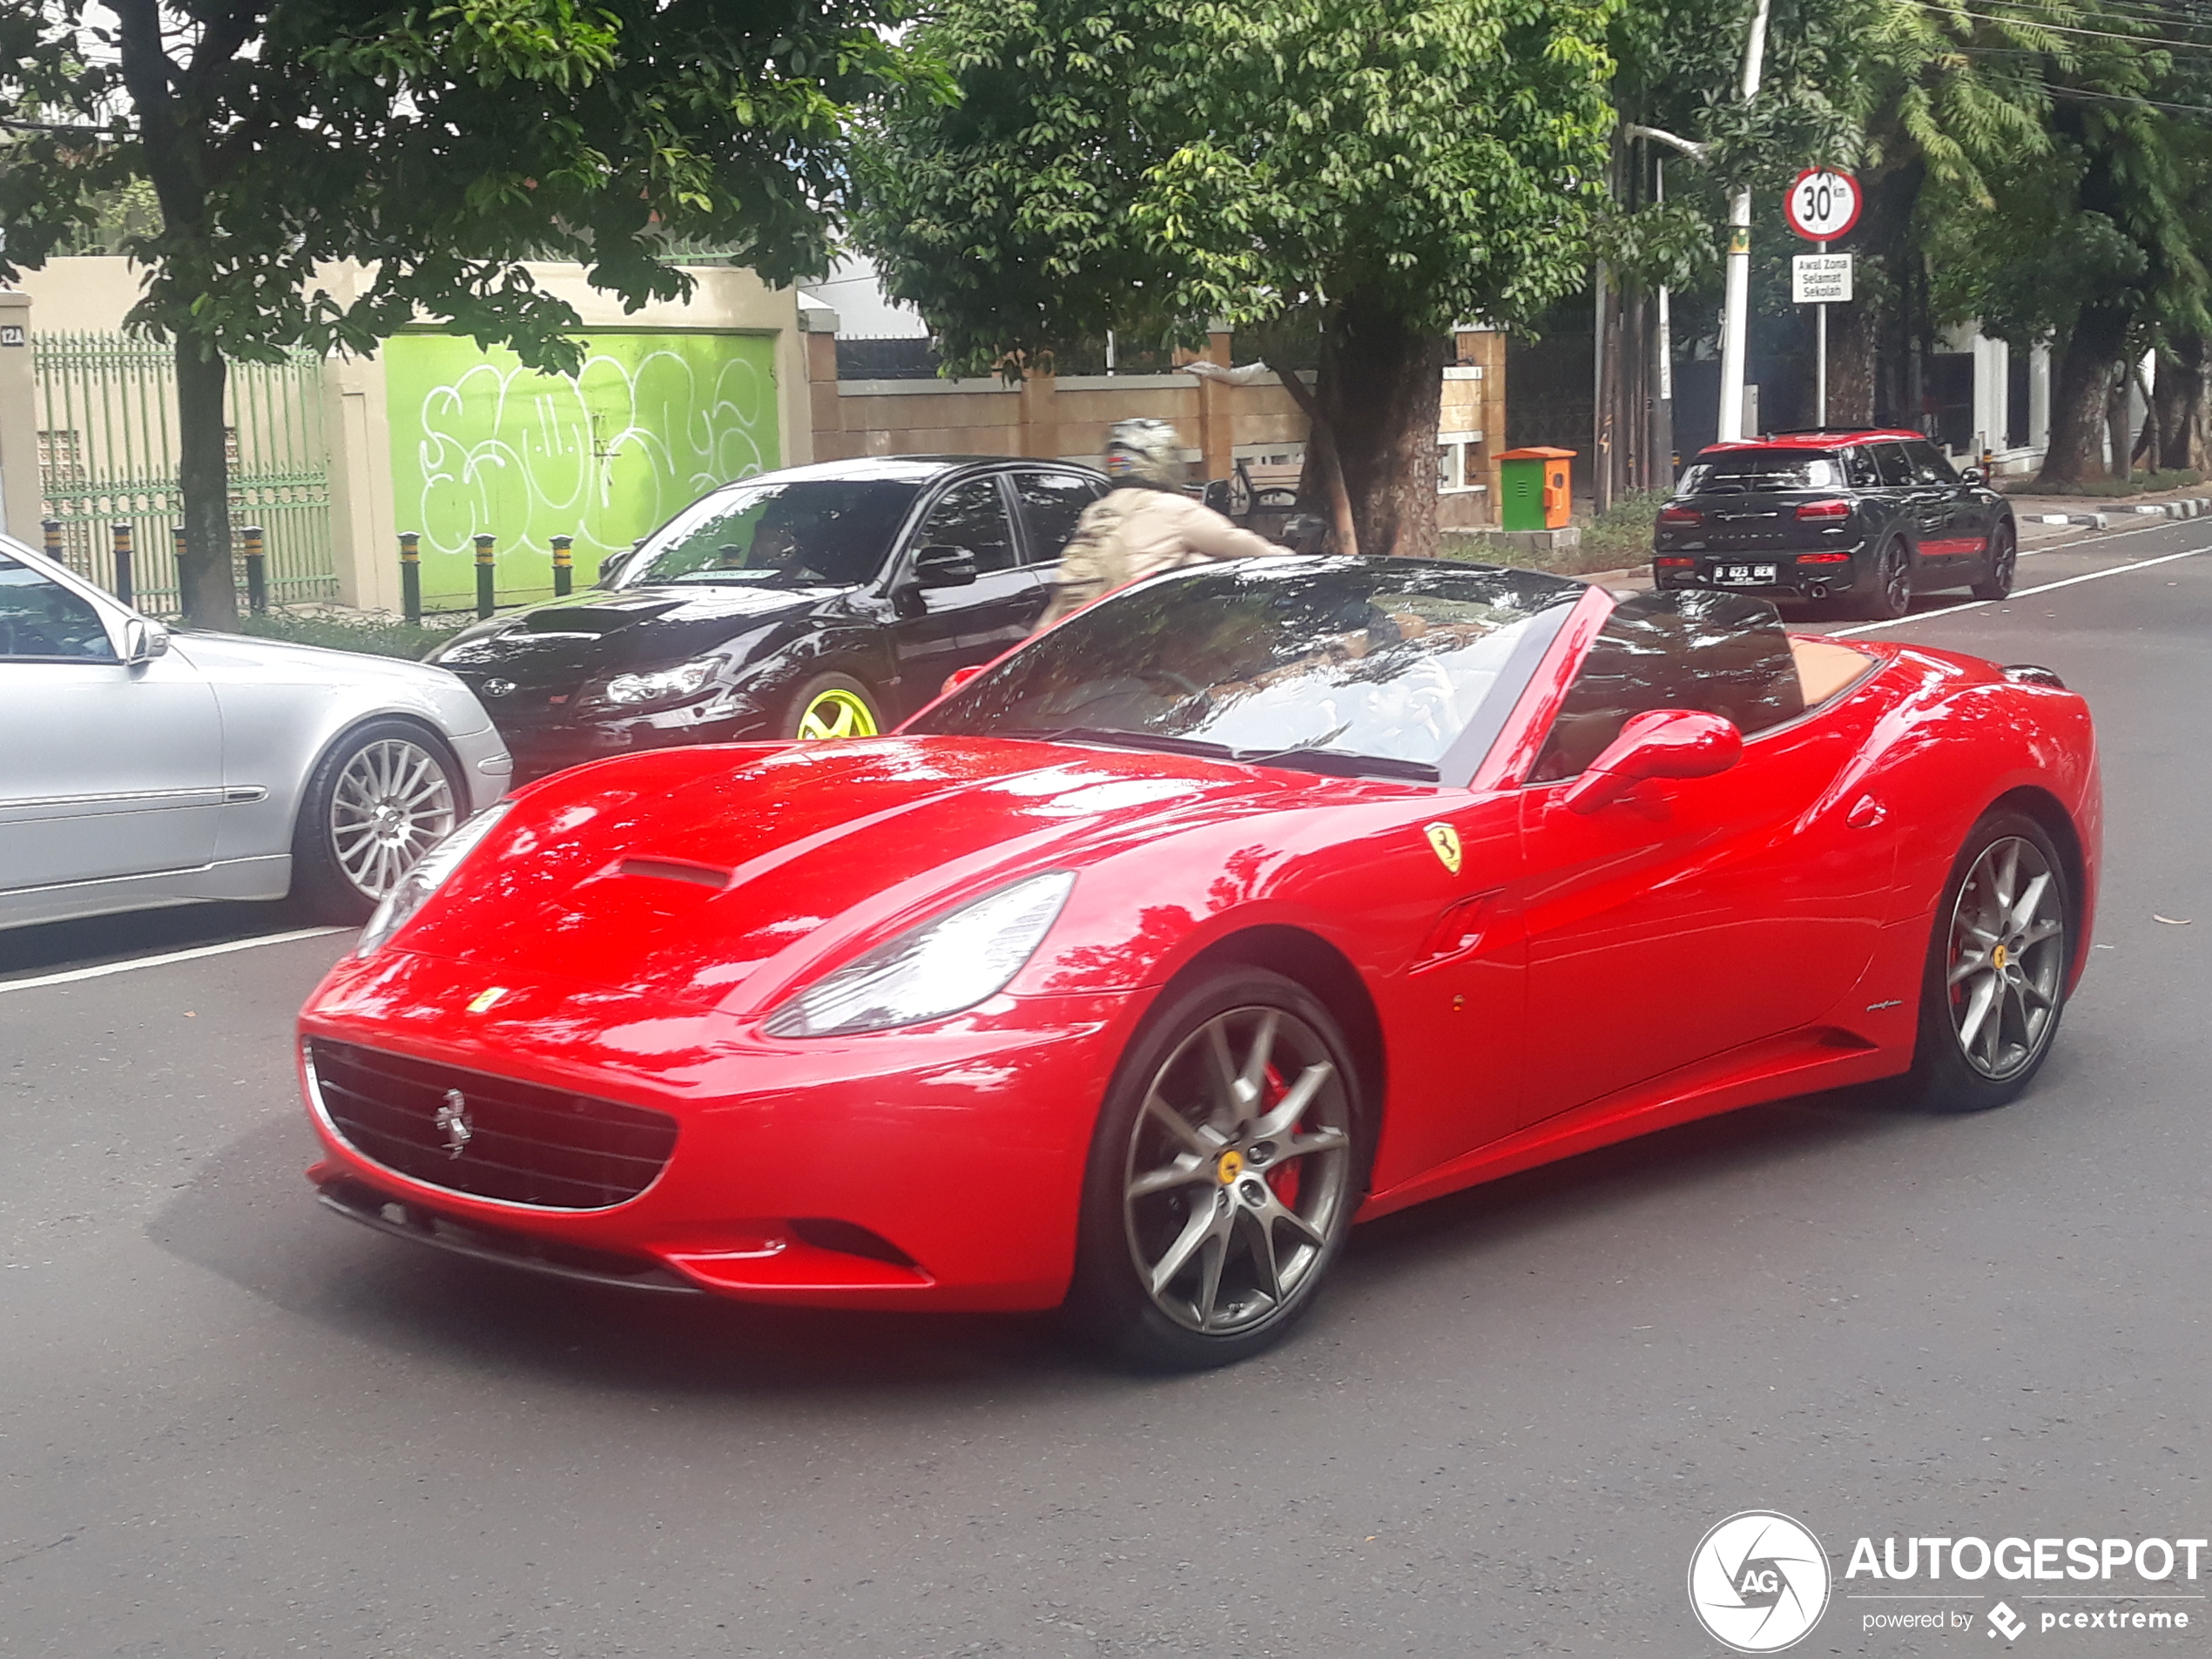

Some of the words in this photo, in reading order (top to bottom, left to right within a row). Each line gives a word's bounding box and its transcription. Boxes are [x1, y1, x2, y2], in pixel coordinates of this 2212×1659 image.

[1804, 185, 1831, 221] 30
[1824, 259, 1848, 269] Zona
[1803, 273, 1841, 284] Selamat
[1804, 286, 1841, 297] Sekolah
[2, 328, 24, 343] 12A
[1716, 567, 1723, 577] B
